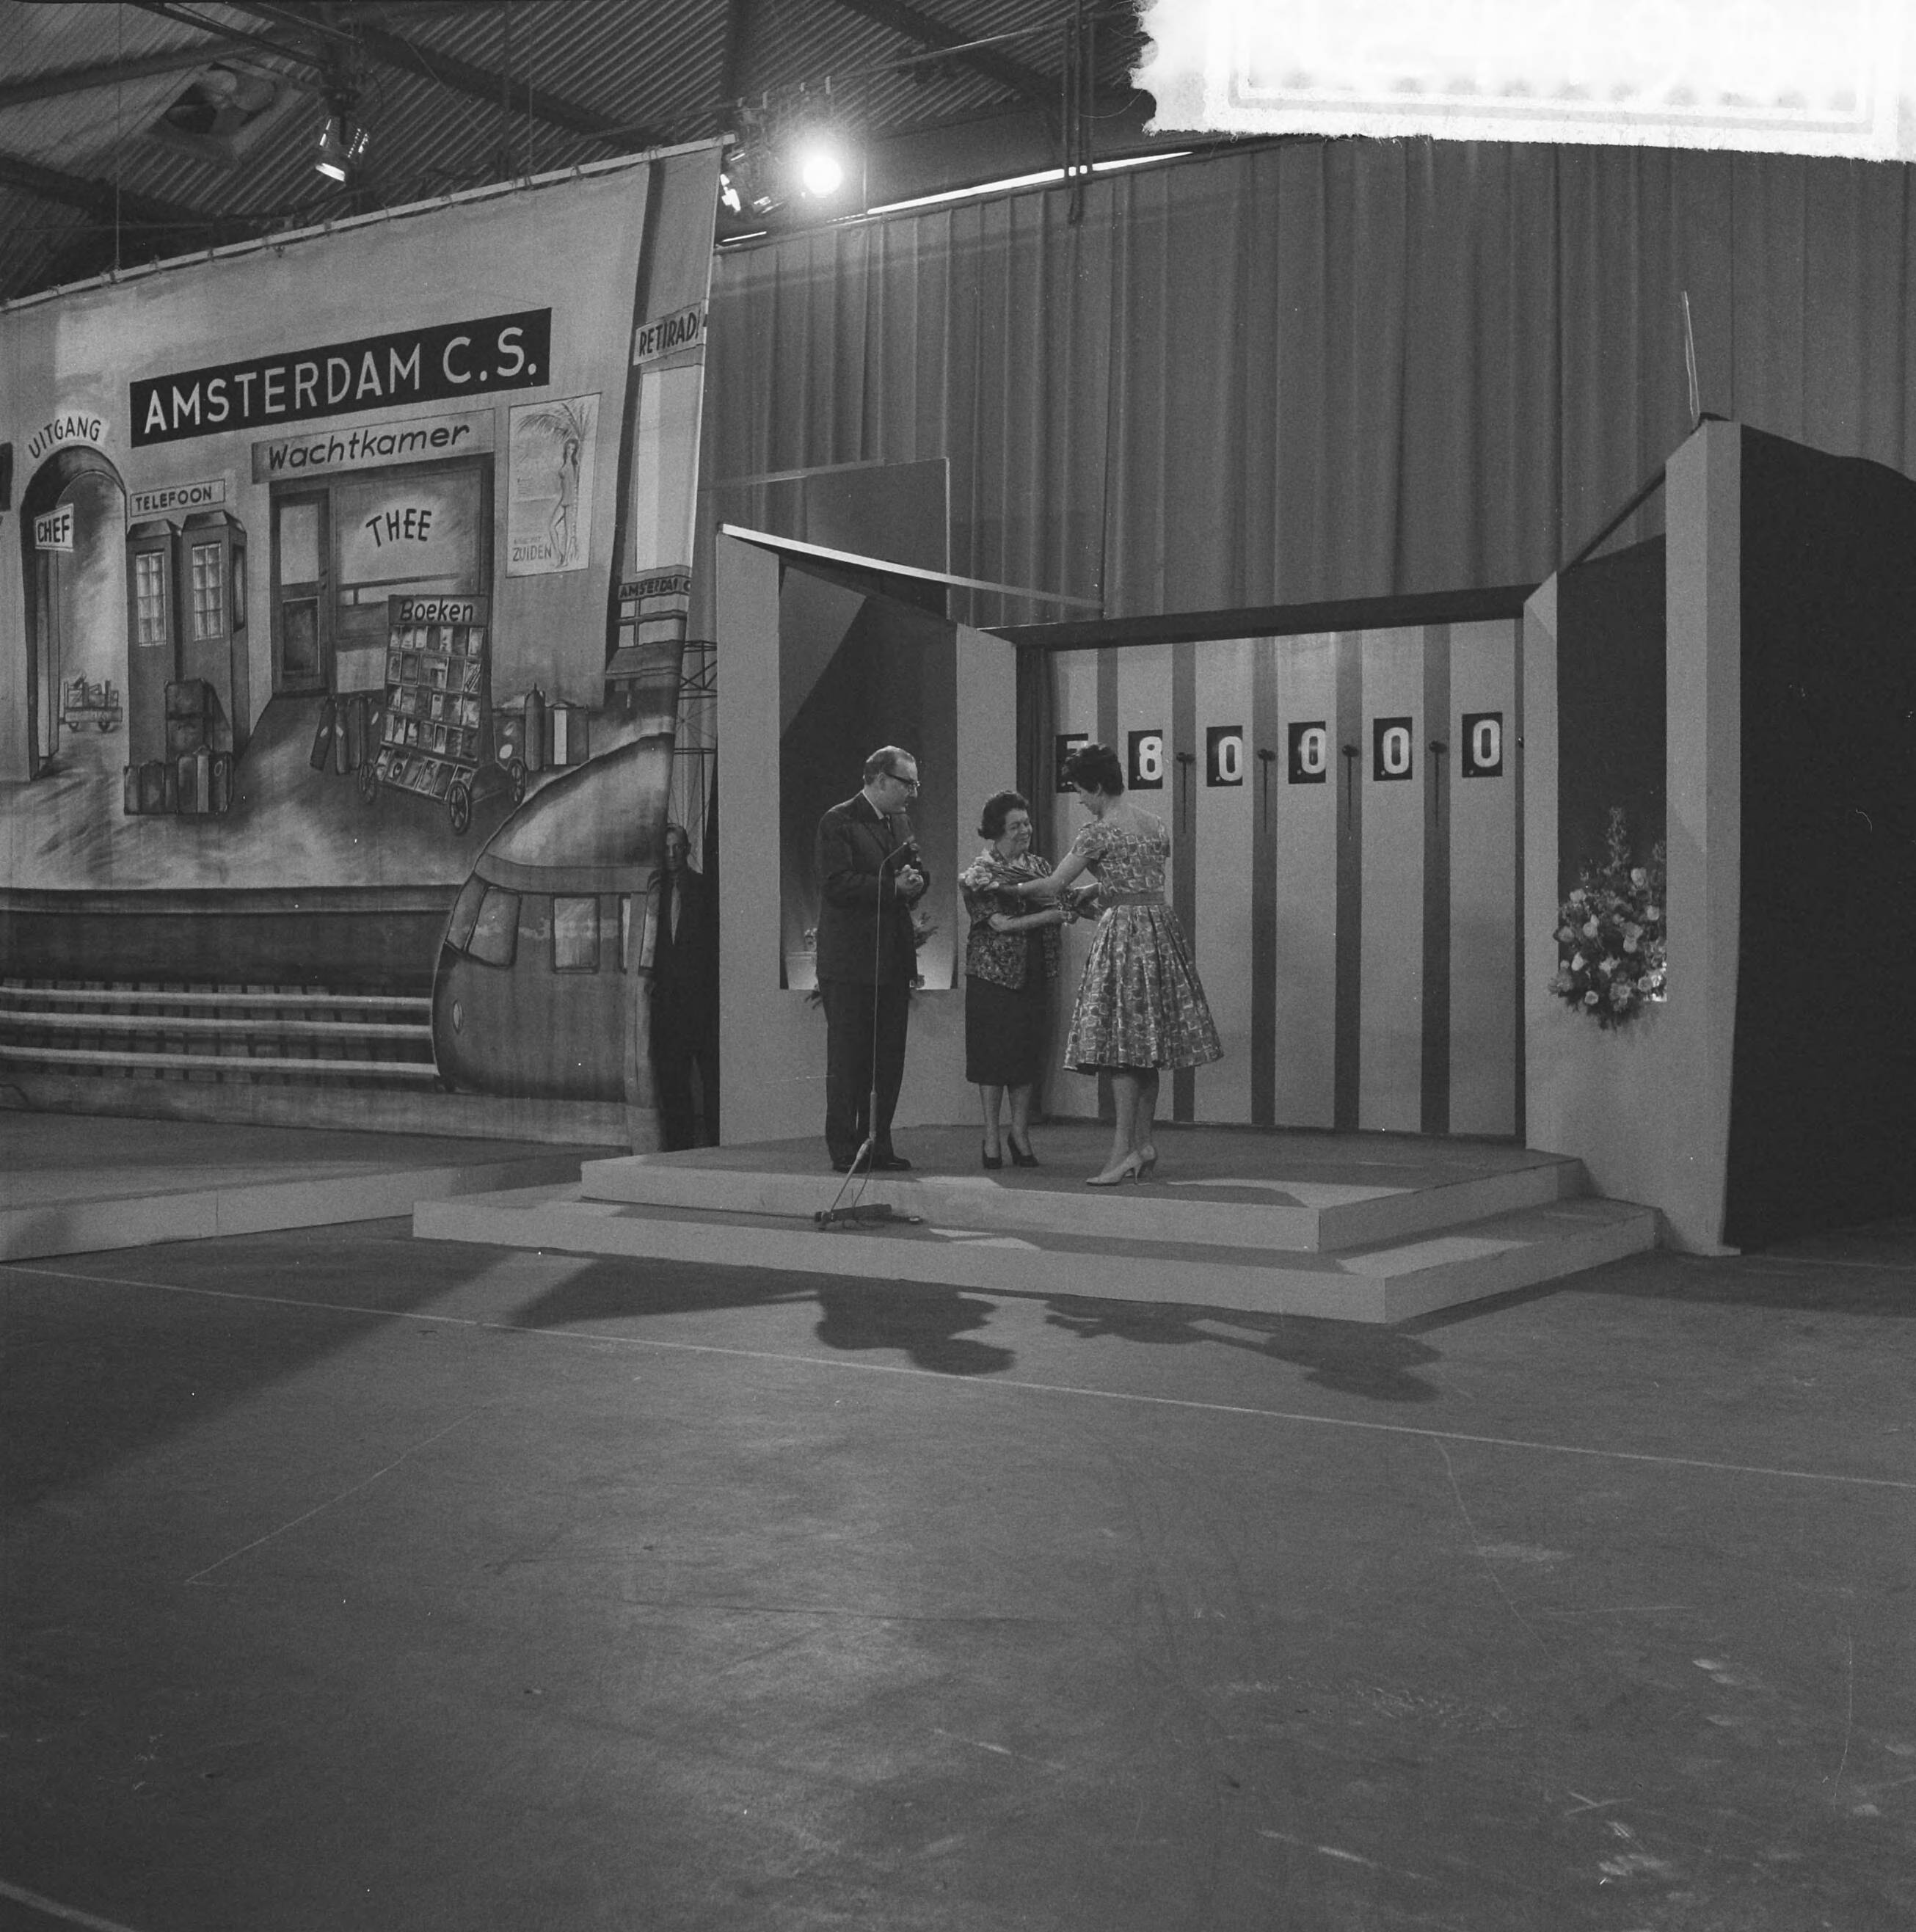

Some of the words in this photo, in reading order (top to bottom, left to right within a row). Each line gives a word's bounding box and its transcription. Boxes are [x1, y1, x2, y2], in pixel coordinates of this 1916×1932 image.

[145, 343, 420, 434] AMSTERDAM
[442, 327, 537, 384] C.S.
[29, 416, 101, 459] UITGANG
[269, 424, 470, 470] Wachtkamer
[136, 486, 212, 511] TELEFOON
[37, 514, 70, 544] CHEF
[365, 508, 432, 547] THEE
[512, 544, 552, 561] ZUIDEN
[400, 597, 473, 622] Boeken
[1139, 736, 1163, 781] 8
